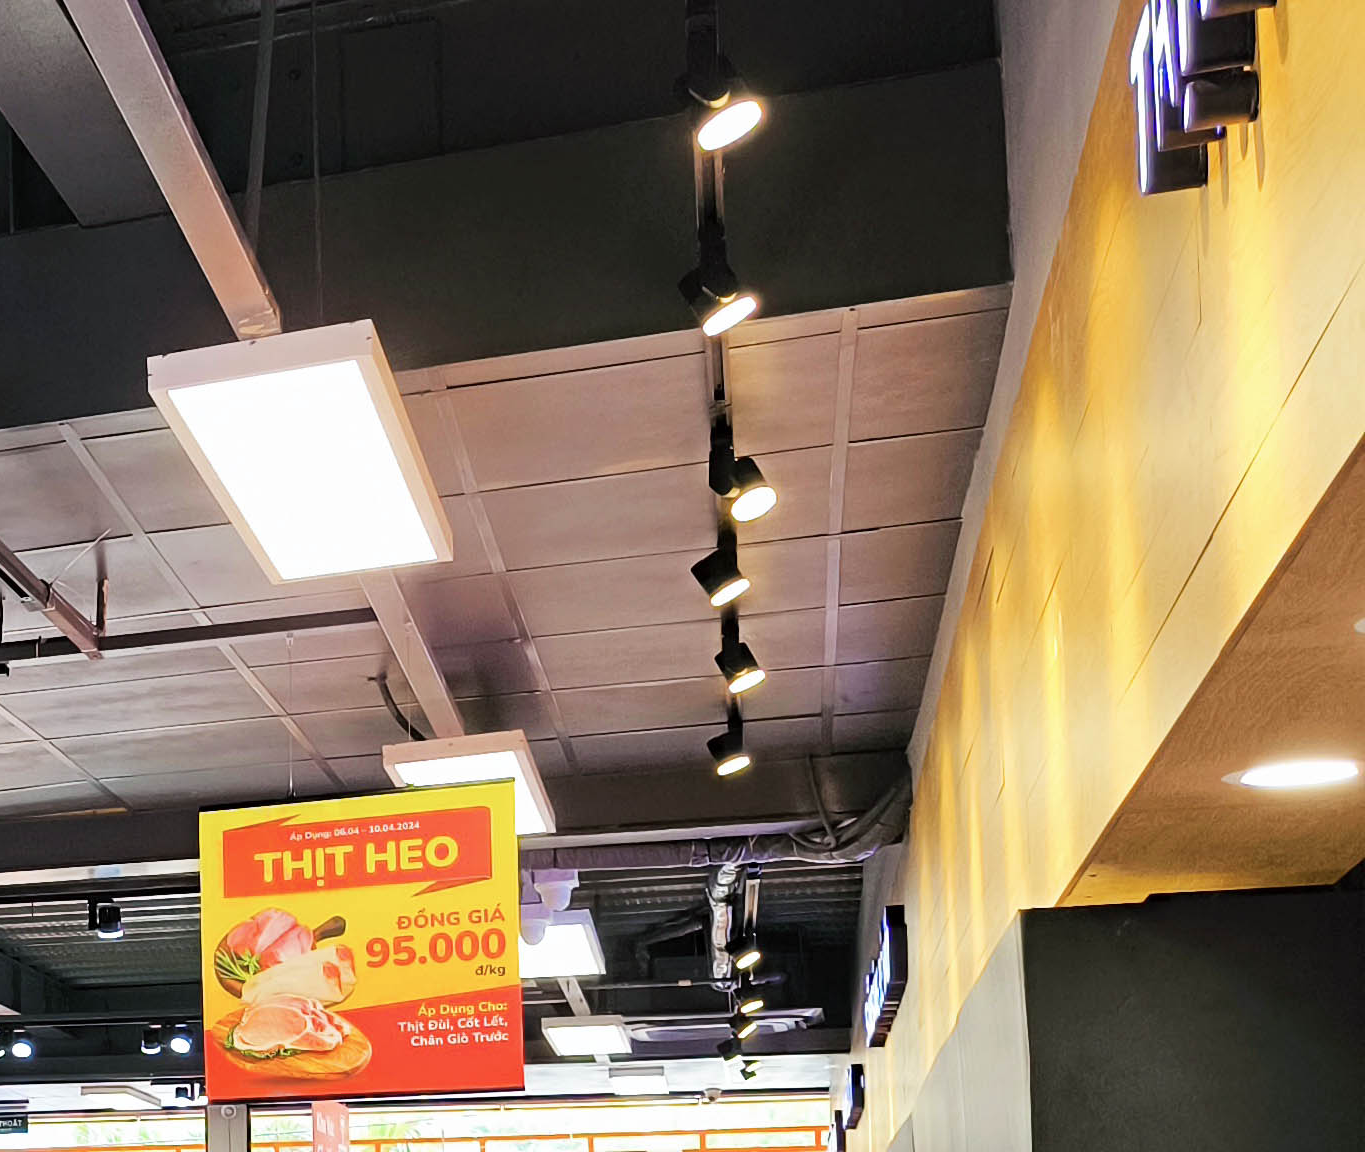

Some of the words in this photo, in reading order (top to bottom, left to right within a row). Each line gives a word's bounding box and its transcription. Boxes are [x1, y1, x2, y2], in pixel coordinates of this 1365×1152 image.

[369, 821, 420, 834] 10.04.2024
[254, 844, 354, 887] THỊT
[366, 835, 459, 874] HEO
[468, 903, 505, 925] GIÁ
[365, 928, 507, 968] 95.000
[475, 964, 506, 977] đ/kg
[417, 1004, 436, 1018] Áp
[439, 1002, 475, 1018] Dụng
[478, 1001, 508, 1014] Cho:
[397, 1020, 425, 1033] Thịt
[457, 1016, 480, 1030] Cốt
[410, 1033, 440, 1048] Chân
[472, 1028, 509, 1043] Trước
